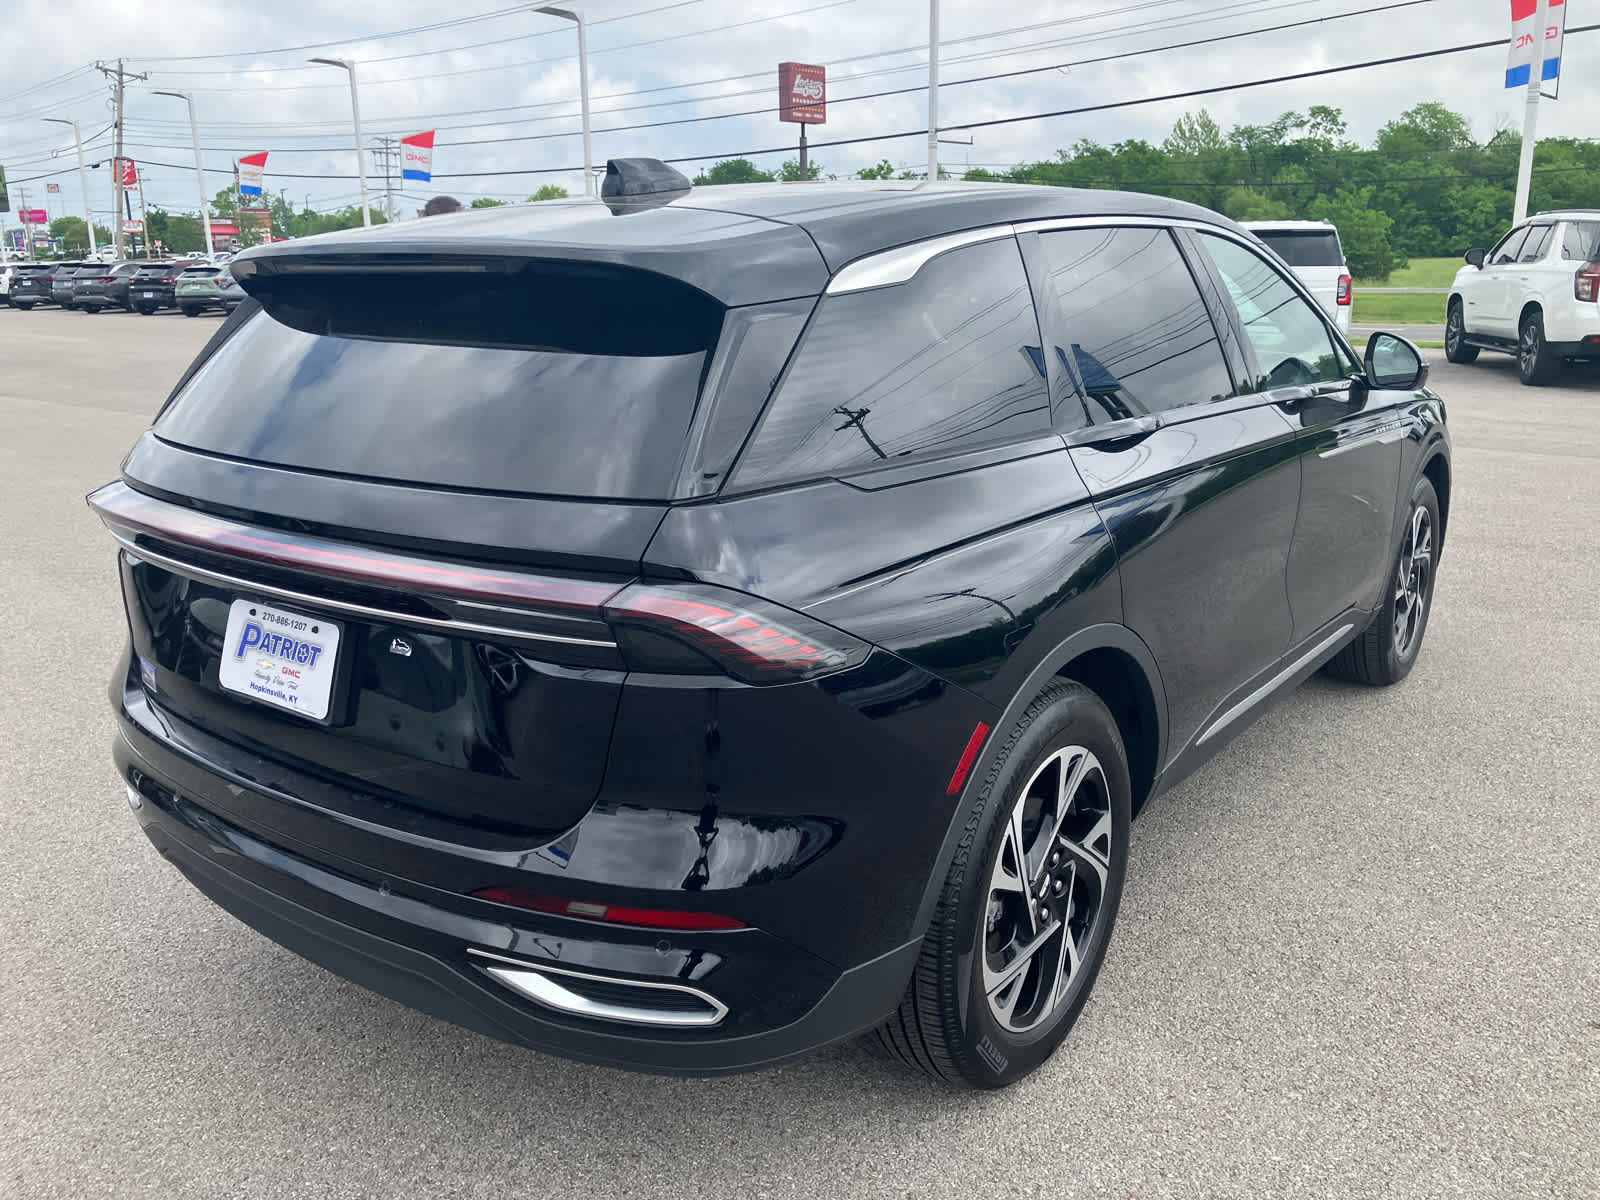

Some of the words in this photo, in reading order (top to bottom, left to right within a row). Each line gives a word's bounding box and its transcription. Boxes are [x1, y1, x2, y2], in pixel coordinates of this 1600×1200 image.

[406, 153, 429, 164] GMC
[236, 622, 322, 667] PATRIOT
[281, 666, 302, 679] GMC
[249, 681, 288, 702] Hopkinsville,
[288, 694, 299, 705] KY
